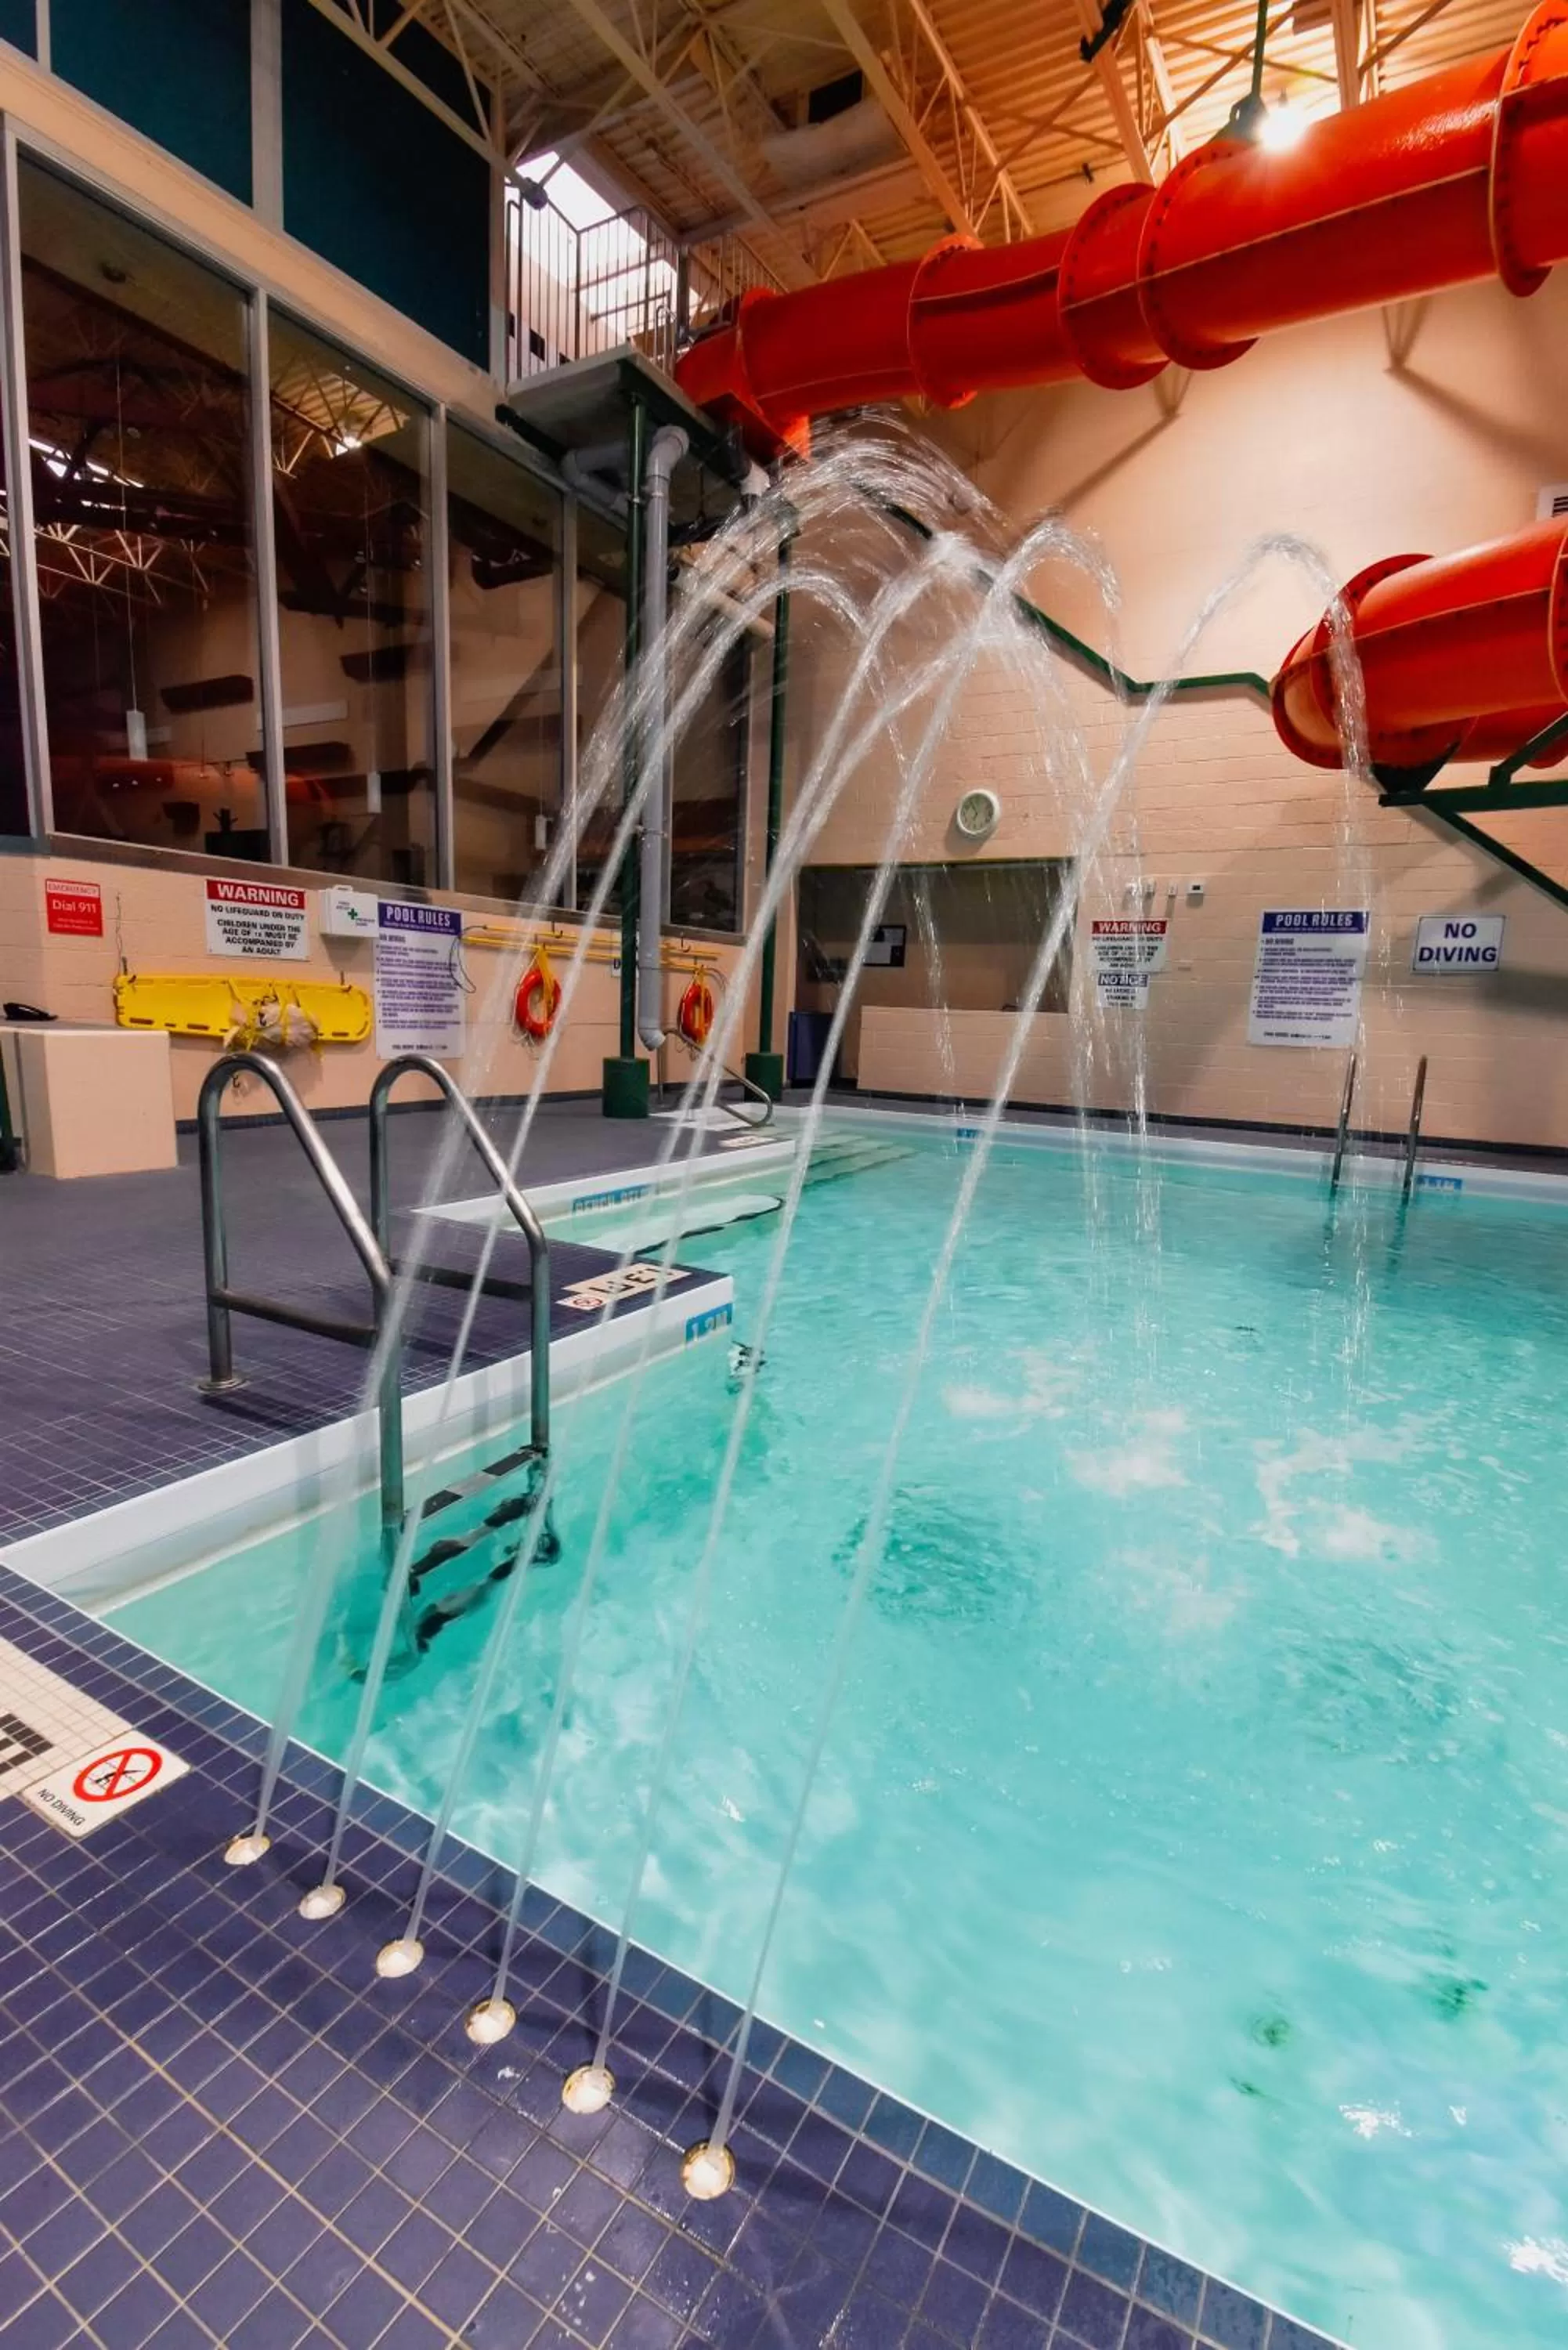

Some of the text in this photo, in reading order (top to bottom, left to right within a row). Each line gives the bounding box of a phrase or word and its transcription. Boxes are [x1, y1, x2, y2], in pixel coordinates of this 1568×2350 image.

[217, 883, 298, 906] WARNING
[52, 898, 96, 913] Dial 911
[211, 904, 223, 913] NO
[226, 905, 270, 917] LIFEGUARD
[285, 912, 304, 920] DUTY
[386, 906, 416, 923] POOL
[417, 909, 450, 927] RULES
[1276, 913, 1353, 927] POOL RULES
[217, 919, 258, 930] CHILDREN
[259, 922, 285, 931] UNDER
[1099, 922, 1162, 933] WARNING
[1444, 923, 1477, 938] NO
[226, 936, 283, 947] ACCOMPANIED
[1418, 946, 1497, 962] DIVING
[1100, 974, 1147, 985] NOTICE
[38, 1788, 85, 1826] NO DIVING
